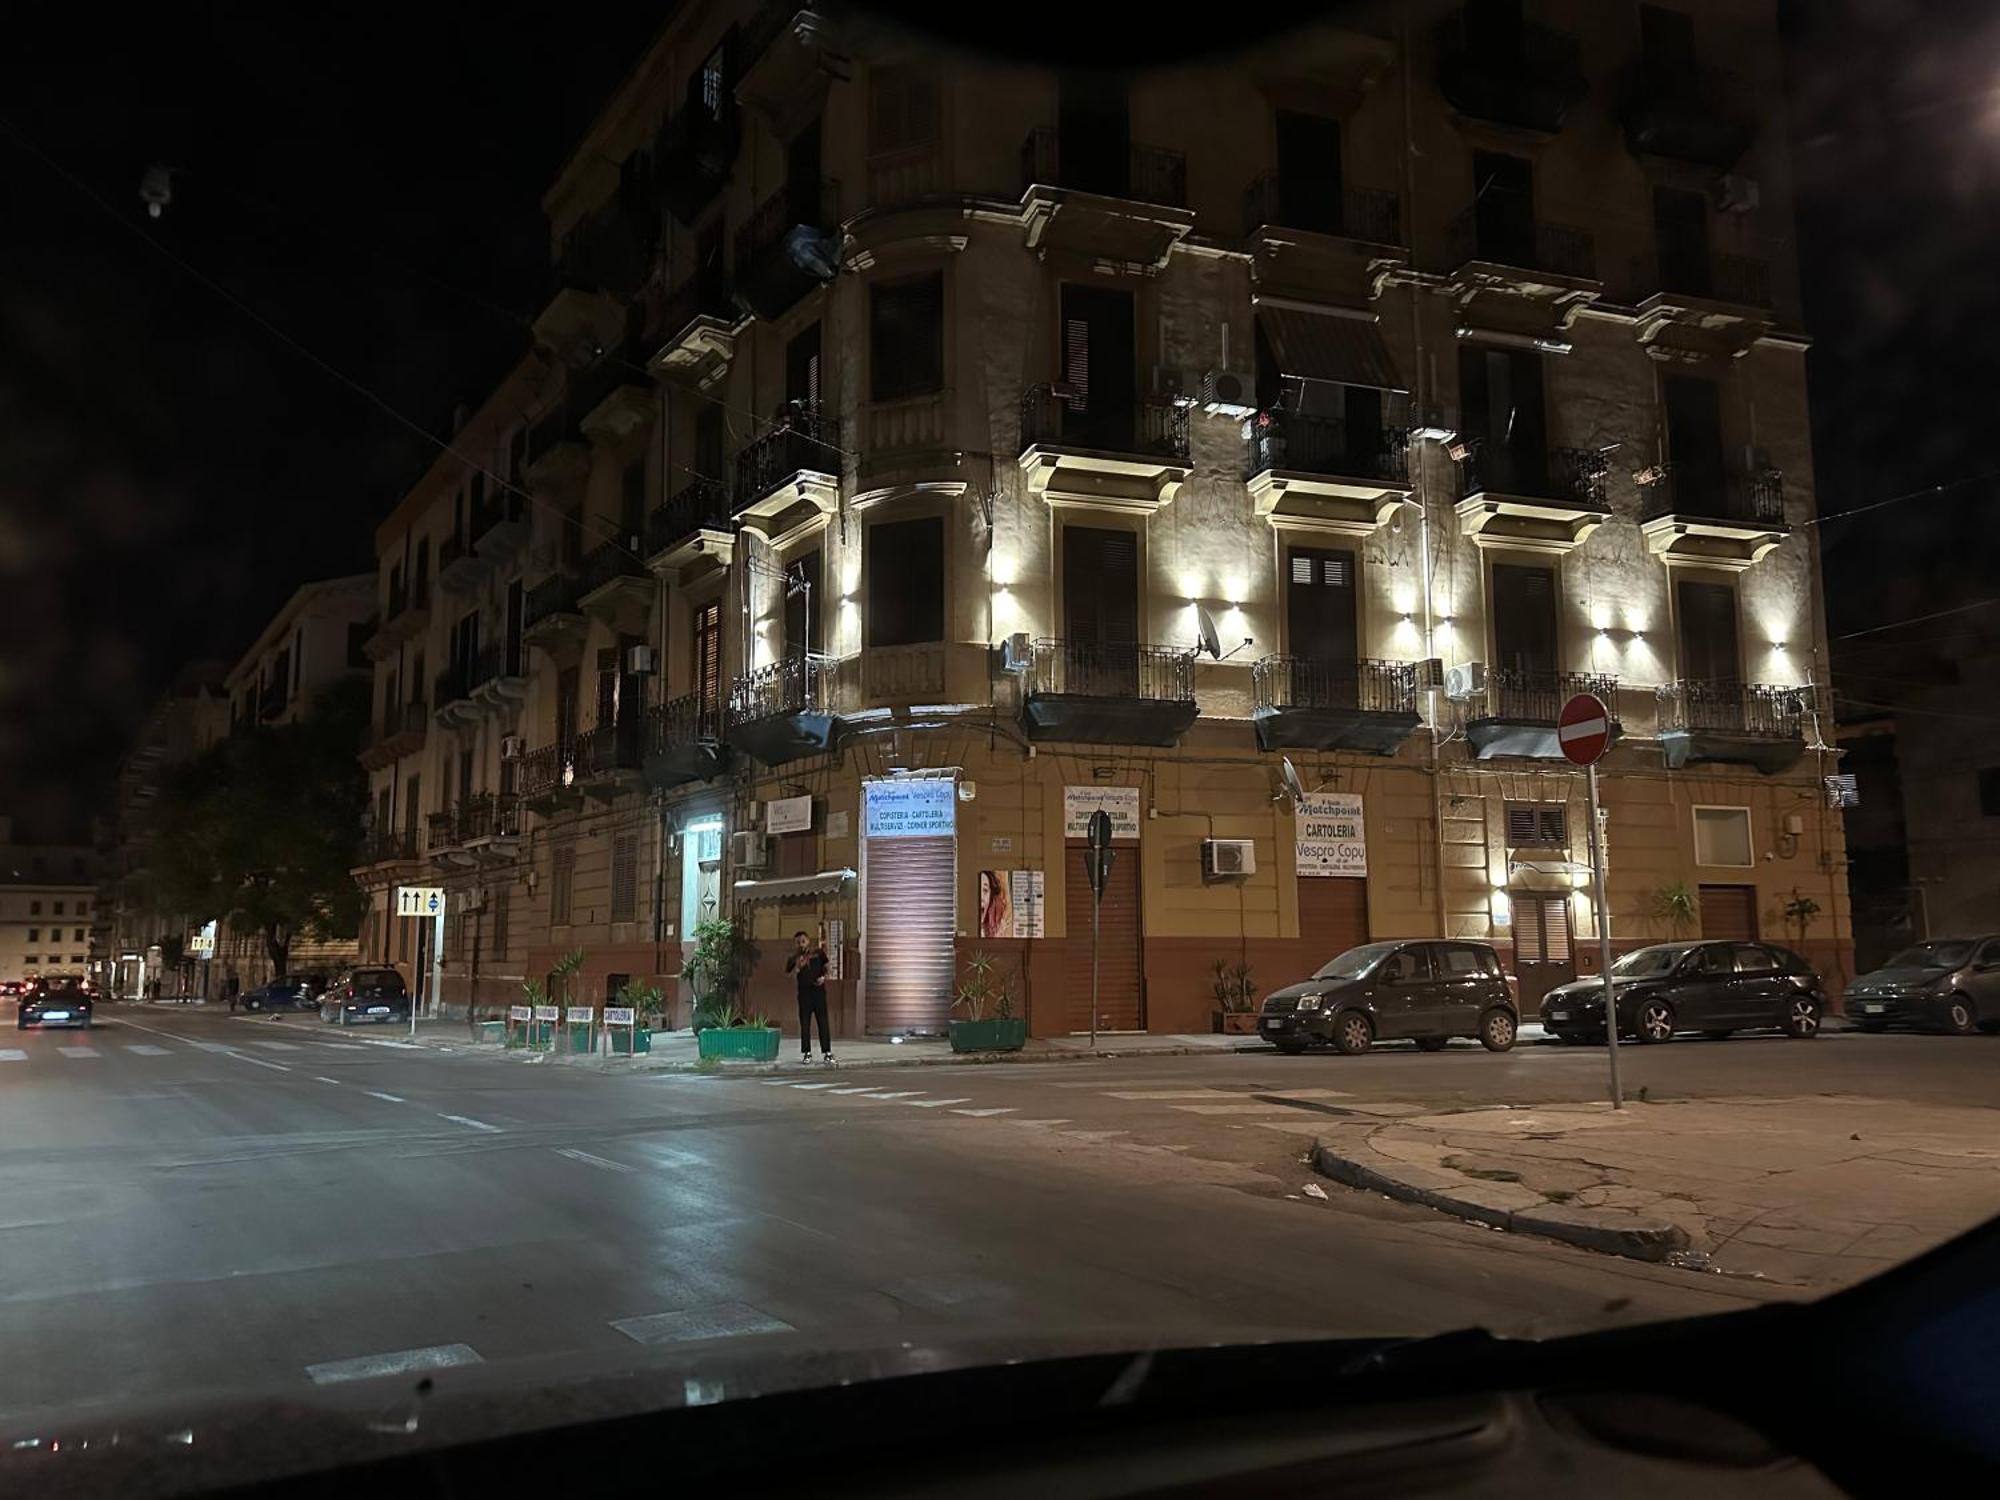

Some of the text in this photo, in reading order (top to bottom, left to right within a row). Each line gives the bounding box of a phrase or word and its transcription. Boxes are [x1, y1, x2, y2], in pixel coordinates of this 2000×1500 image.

[912, 809, 943, 818] CARTOLERIA
[1298, 804, 1361, 816] Matchpoint
[1306, 823, 1356, 838] CARTOLERIA
[1296, 842, 1365, 861] Vespro Copy
